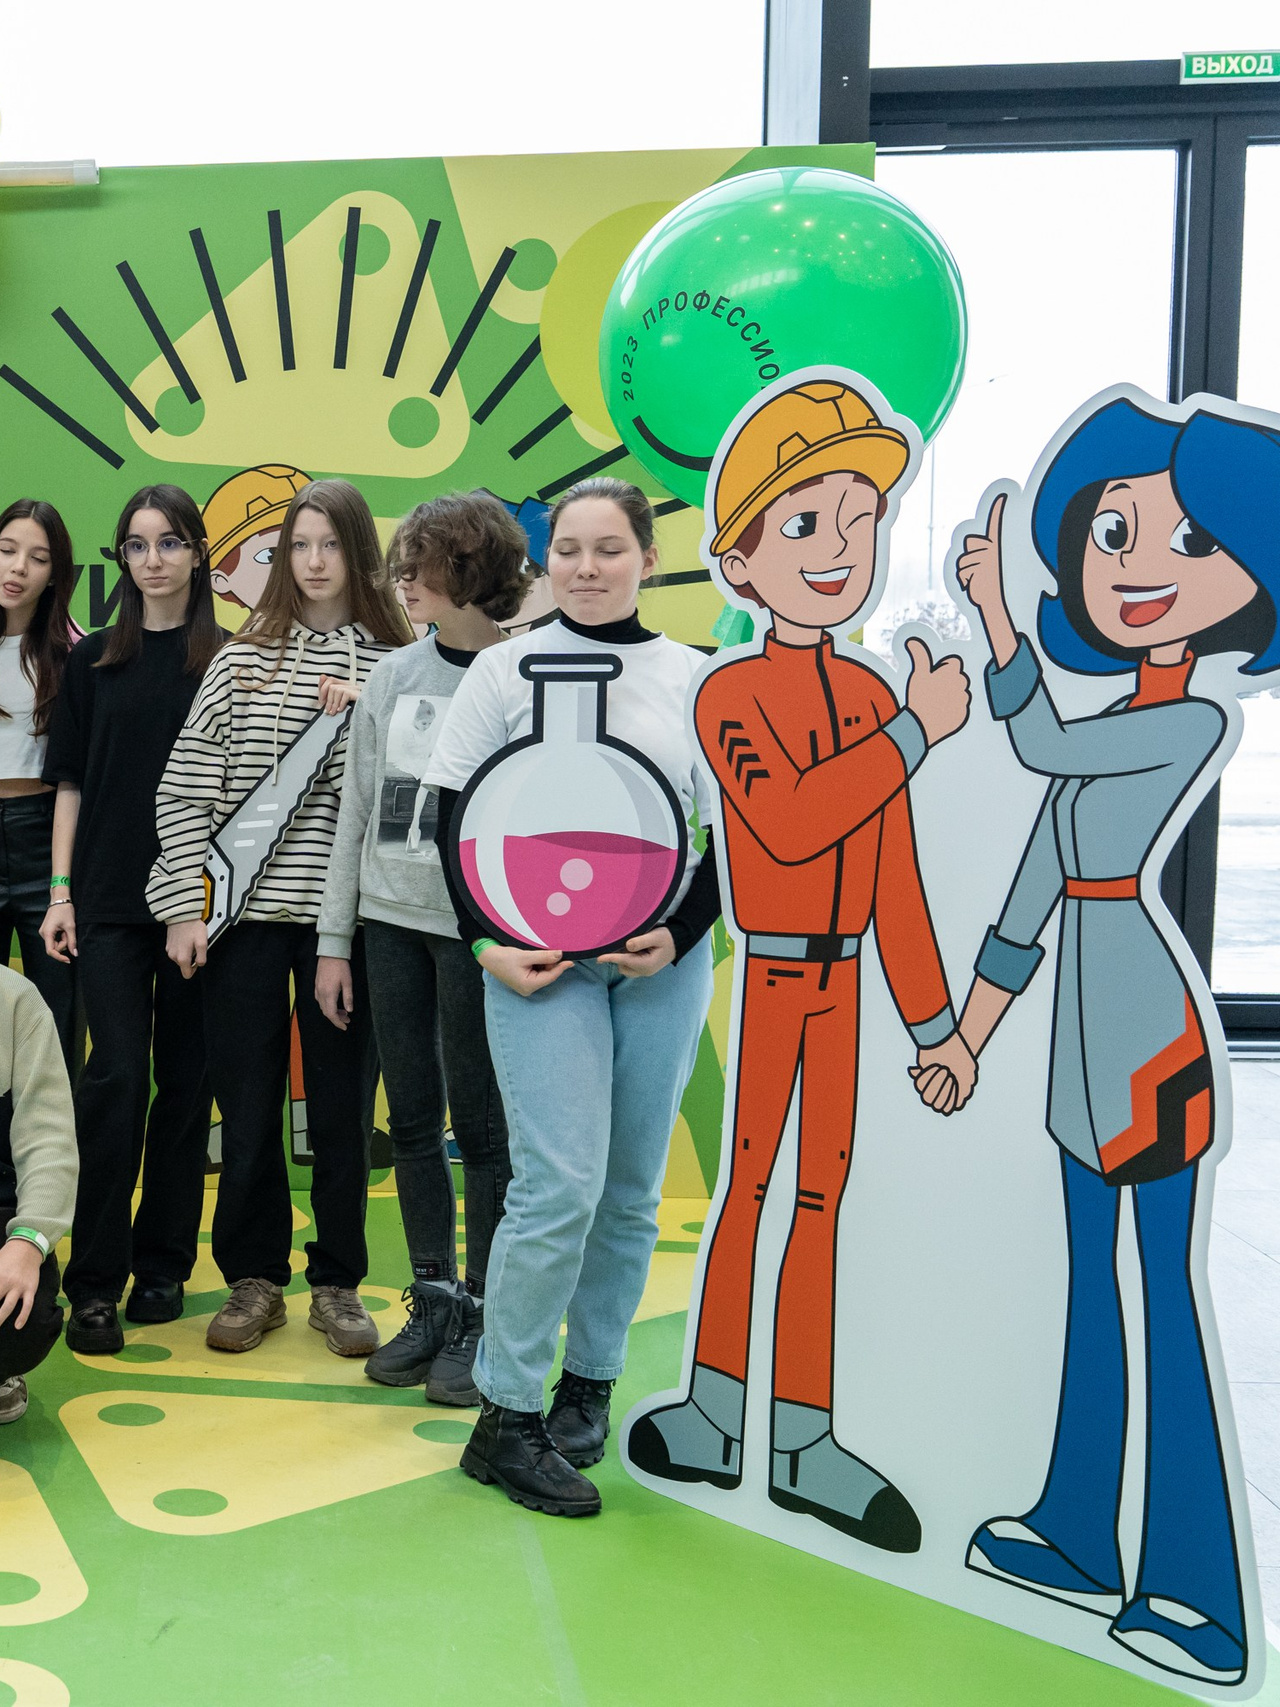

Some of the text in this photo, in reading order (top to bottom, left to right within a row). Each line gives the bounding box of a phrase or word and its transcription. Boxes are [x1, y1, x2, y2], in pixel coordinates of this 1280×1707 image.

[1192, 55, 1274, 75] ВЫХОД
[621, 289, 780, 402] 2023 ПРОФЕССИО
